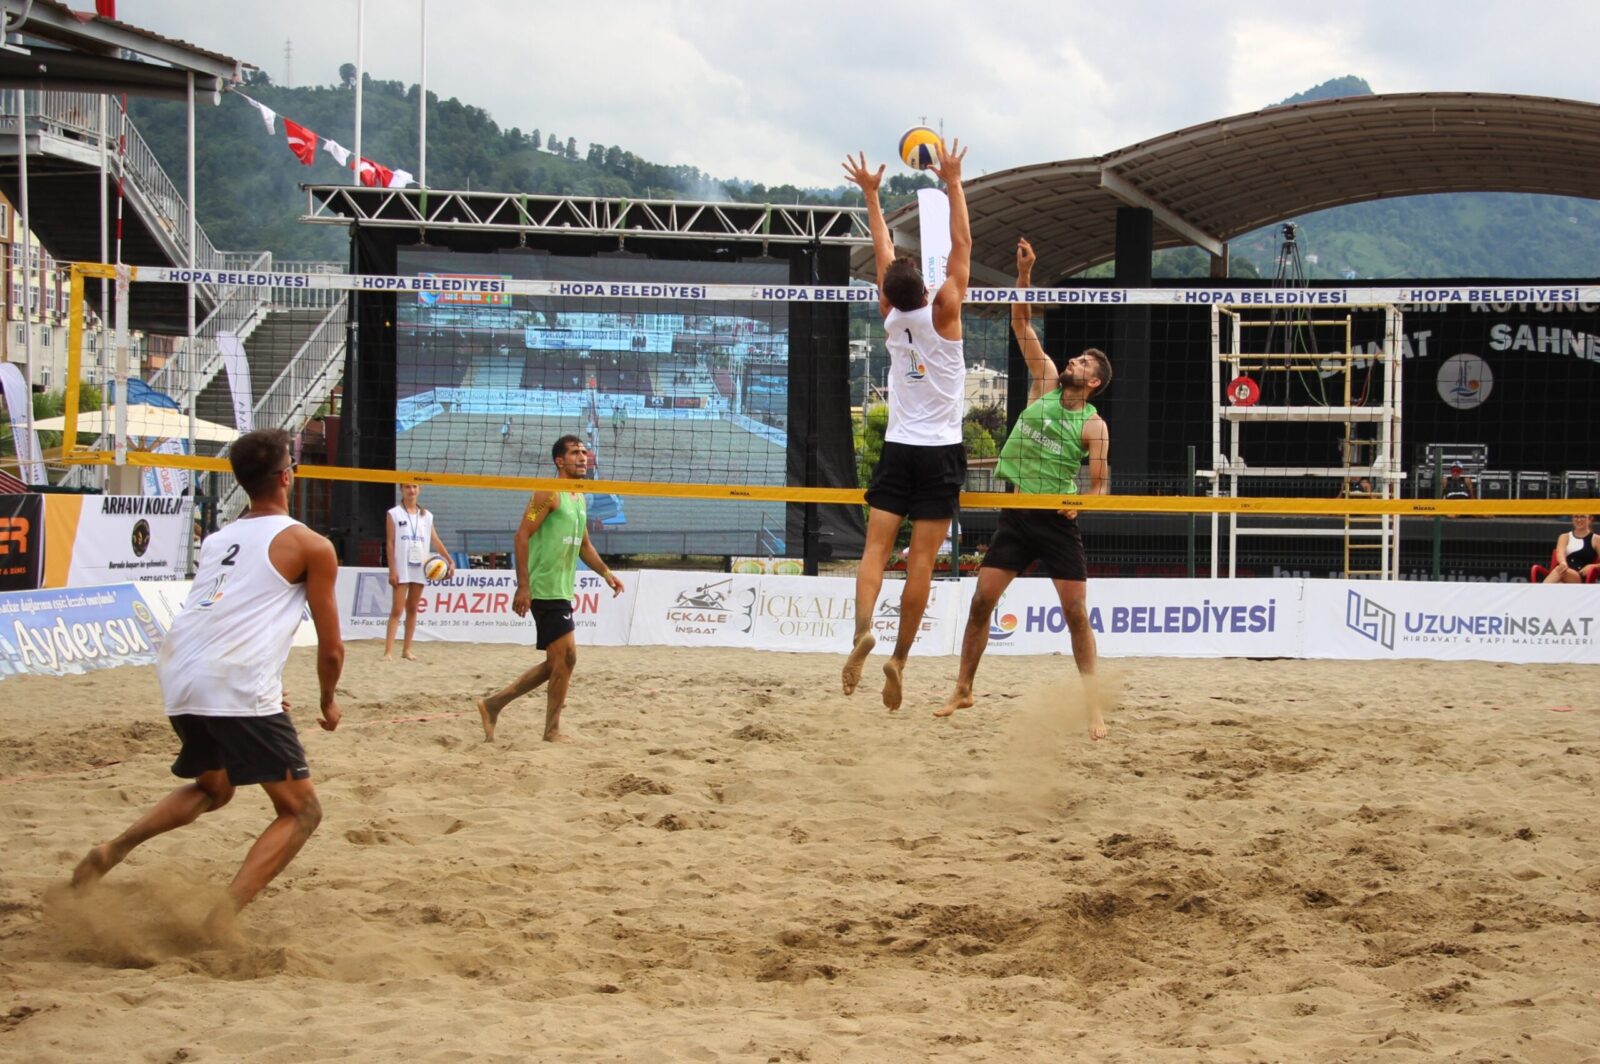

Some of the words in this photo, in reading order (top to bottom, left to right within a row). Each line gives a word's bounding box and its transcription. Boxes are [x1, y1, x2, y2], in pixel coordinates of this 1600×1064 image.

[169, 270, 213, 284] HOPA
[217, 273, 310, 288] BELEDİYESİ
[362, 277, 407, 290] HOPA
[411, 279, 506, 293] BELEDİYESİ
[560, 283, 605, 296] HOPA
[610, 284, 707, 299] BELEDİYESİ
[762, 287, 808, 300] HOPA
[971, 290, 1020, 302] HOPA
[1024, 290, 1128, 303] BELEDİYESİ
[1185, 291, 1235, 304] HOPA
[1241, 289, 1348, 304] BELEDİYESİ
[1410, 290, 1462, 302] HOPA
[1468, 287, 1580, 303] BELEDİYESİ
[904, 327, 914, 344] 1
[221, 543, 241, 566] 2
[466, 574, 511, 589] İNŞAAT
[434, 592, 509, 614] HAZIR
[665, 611, 728, 624] İÇKALE
[1025, 606, 1105, 634] HOA
[1111, 599, 1276, 633] BELEDİYESİ
[675, 625, 718, 635] İNŞAAT
[870, 619, 932, 632] İÇKE
